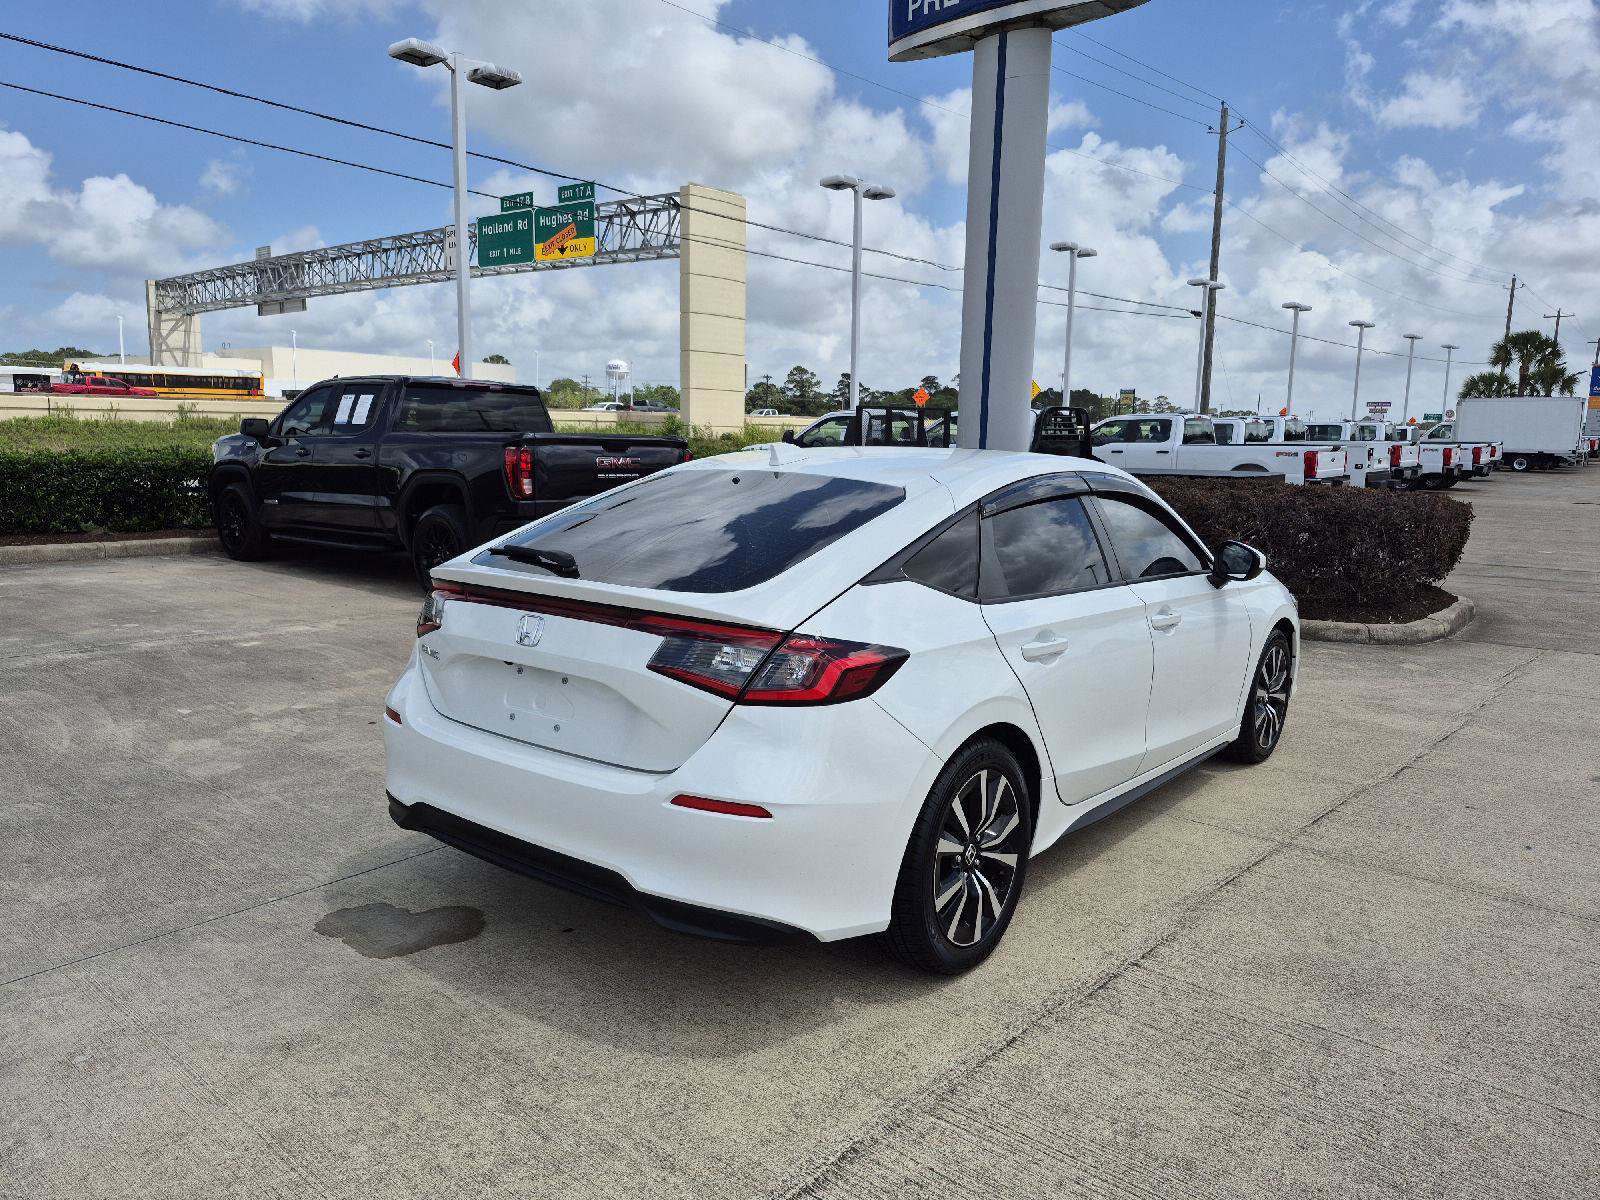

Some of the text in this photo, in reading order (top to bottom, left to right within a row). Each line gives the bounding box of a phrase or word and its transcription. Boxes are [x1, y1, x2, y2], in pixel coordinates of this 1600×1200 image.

[561, 185, 592, 199] EXIT 17 A
[539, 208, 589, 228] Hughes Rd
[482, 218, 528, 236] Holland Rd
[489, 249, 501, 258] EXIT
[509, 247, 522, 256] MILE
[569, 243, 588, 253] ONLY
[596, 456, 641, 469] GMC
